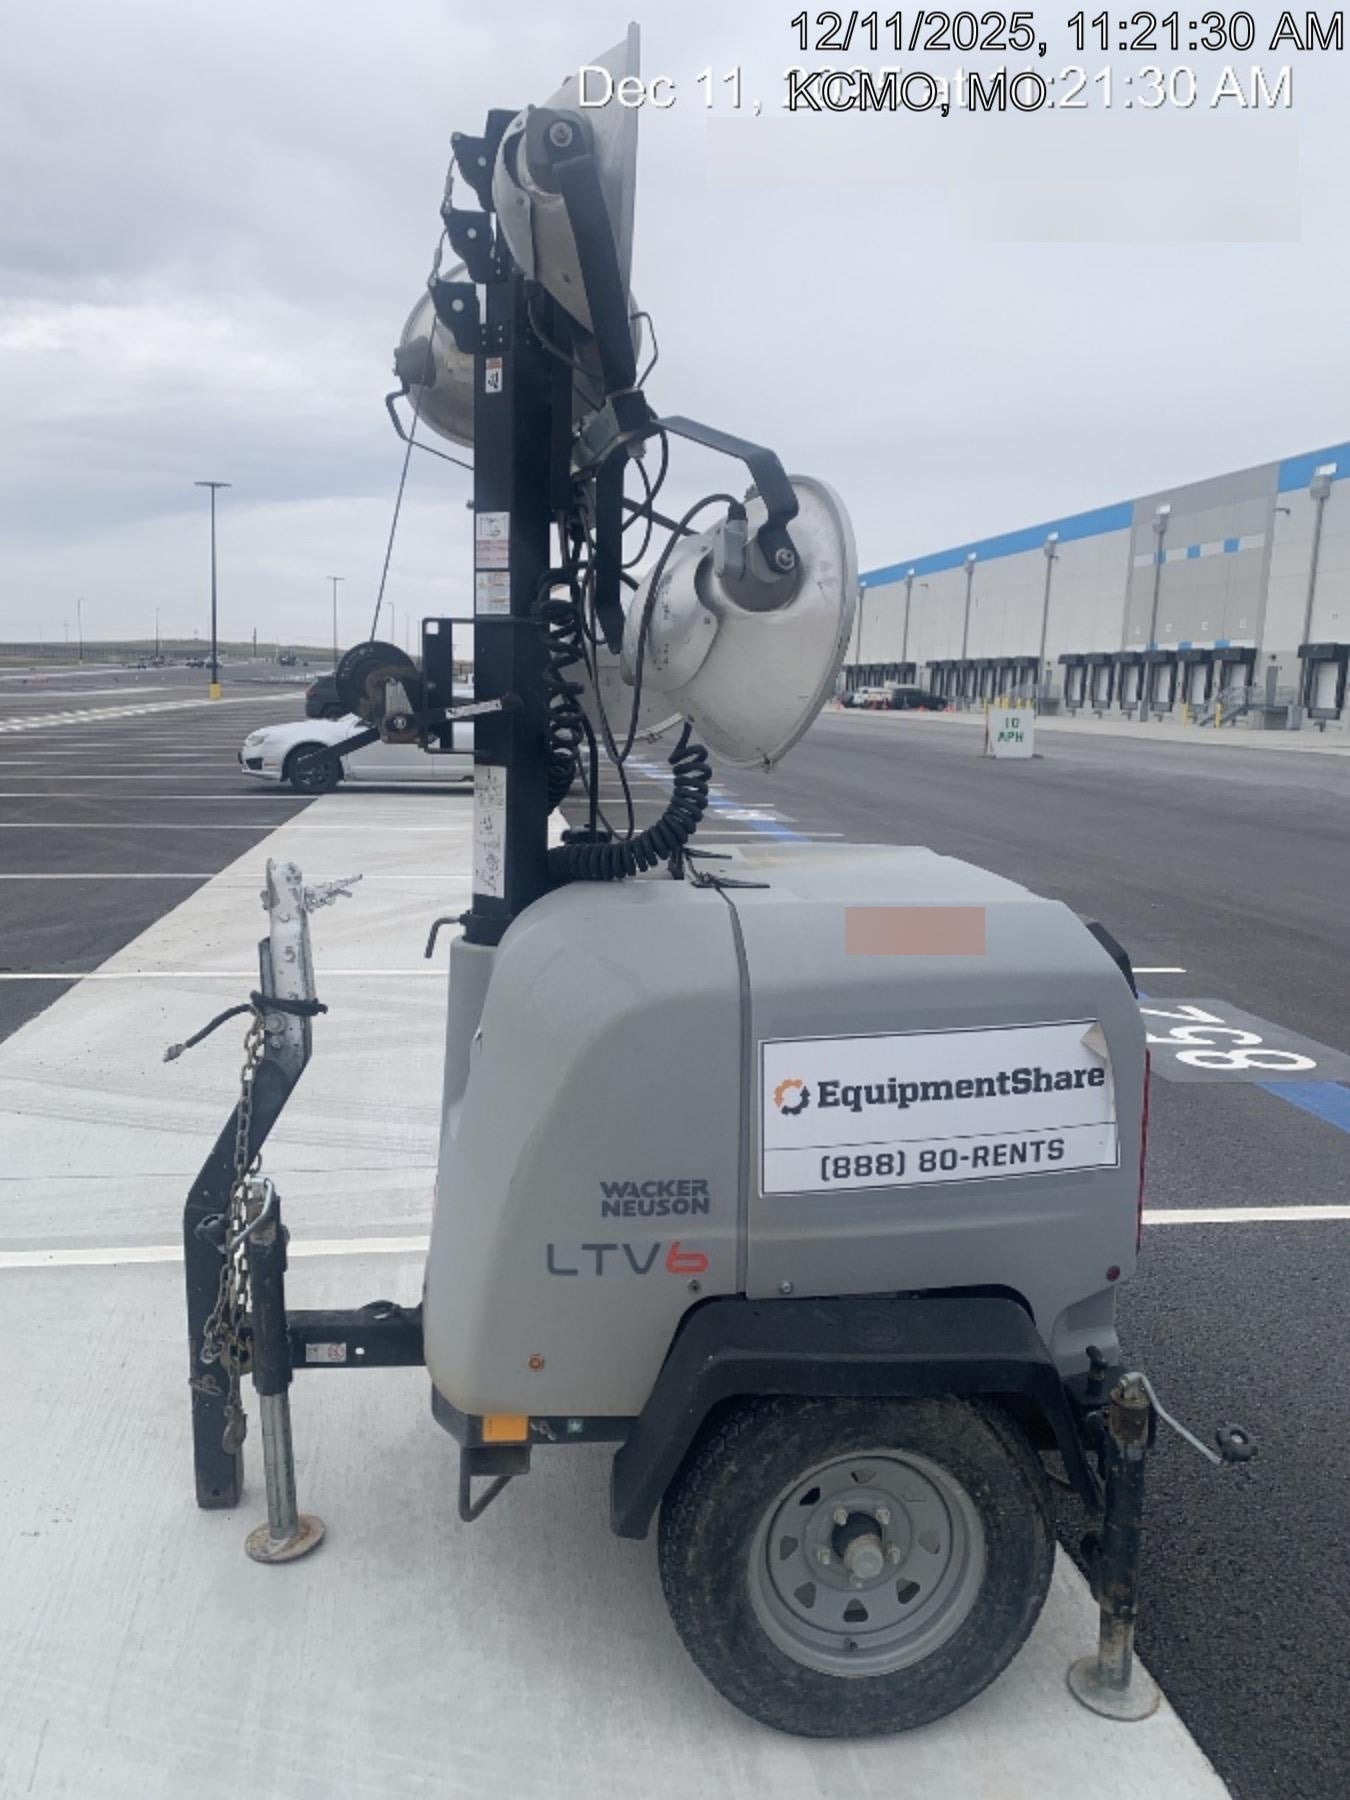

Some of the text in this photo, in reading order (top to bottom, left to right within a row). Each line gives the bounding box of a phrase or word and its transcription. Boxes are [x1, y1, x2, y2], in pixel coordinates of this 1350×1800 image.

[816, 1067, 1105, 1113] EquipmentShare
[820, 1138, 1066, 1182] (888) 80-RENTS
[600, 1179, 710, 1199] WACKER
[601, 1198, 710, 1218] NEUSON
[546, 1240, 710, 1277] LTV6
